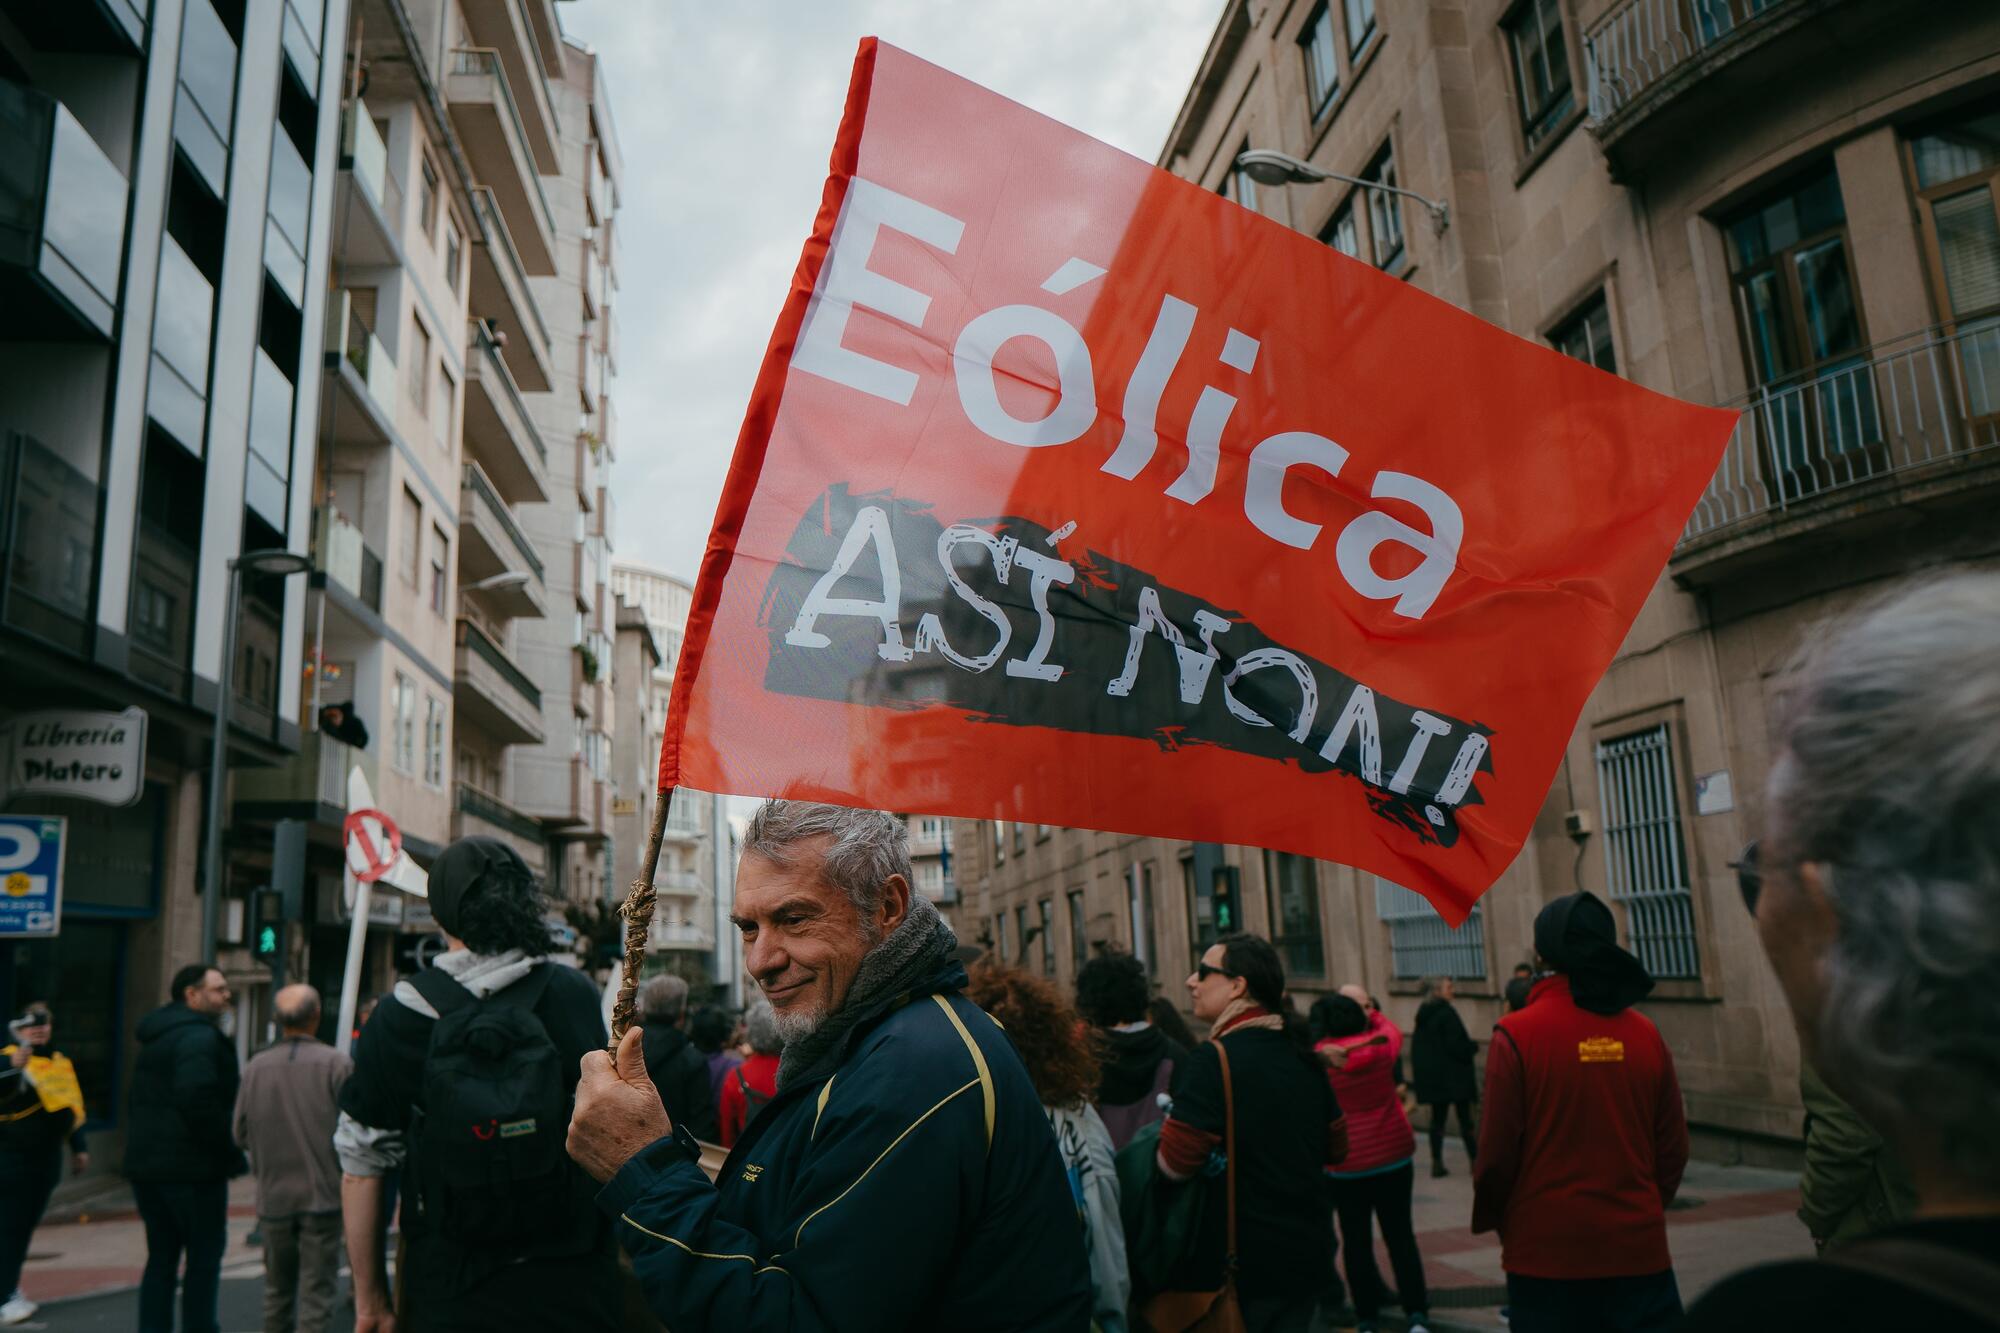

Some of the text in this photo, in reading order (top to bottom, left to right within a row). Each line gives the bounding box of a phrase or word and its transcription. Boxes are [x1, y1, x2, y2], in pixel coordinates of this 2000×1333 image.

[789, 175, 1464, 619] Eólica
[23, 723, 126, 748] Librería
[785, 506, 1489, 827] ASÍ NON!
[23, 759, 123, 782] Platero
